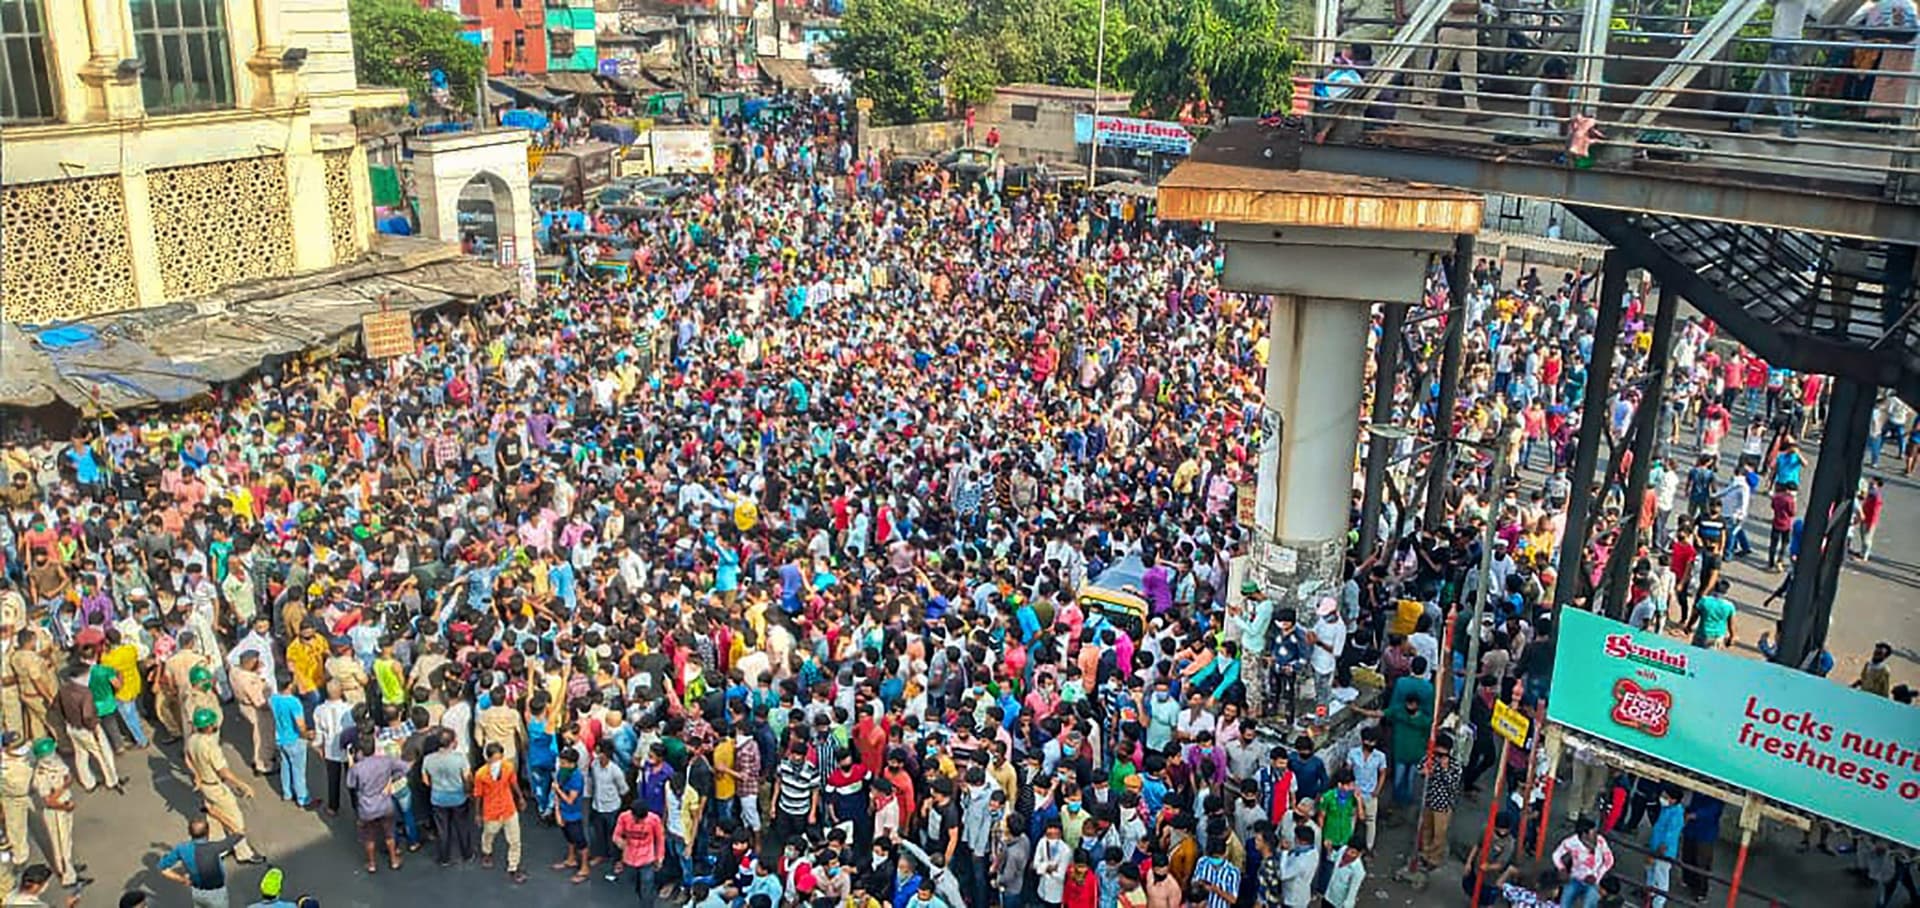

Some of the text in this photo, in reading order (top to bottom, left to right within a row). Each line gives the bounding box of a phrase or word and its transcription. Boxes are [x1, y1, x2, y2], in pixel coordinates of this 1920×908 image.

[1745, 696, 1833, 742] Locks
[1738, 723, 1920, 800] freshness o
